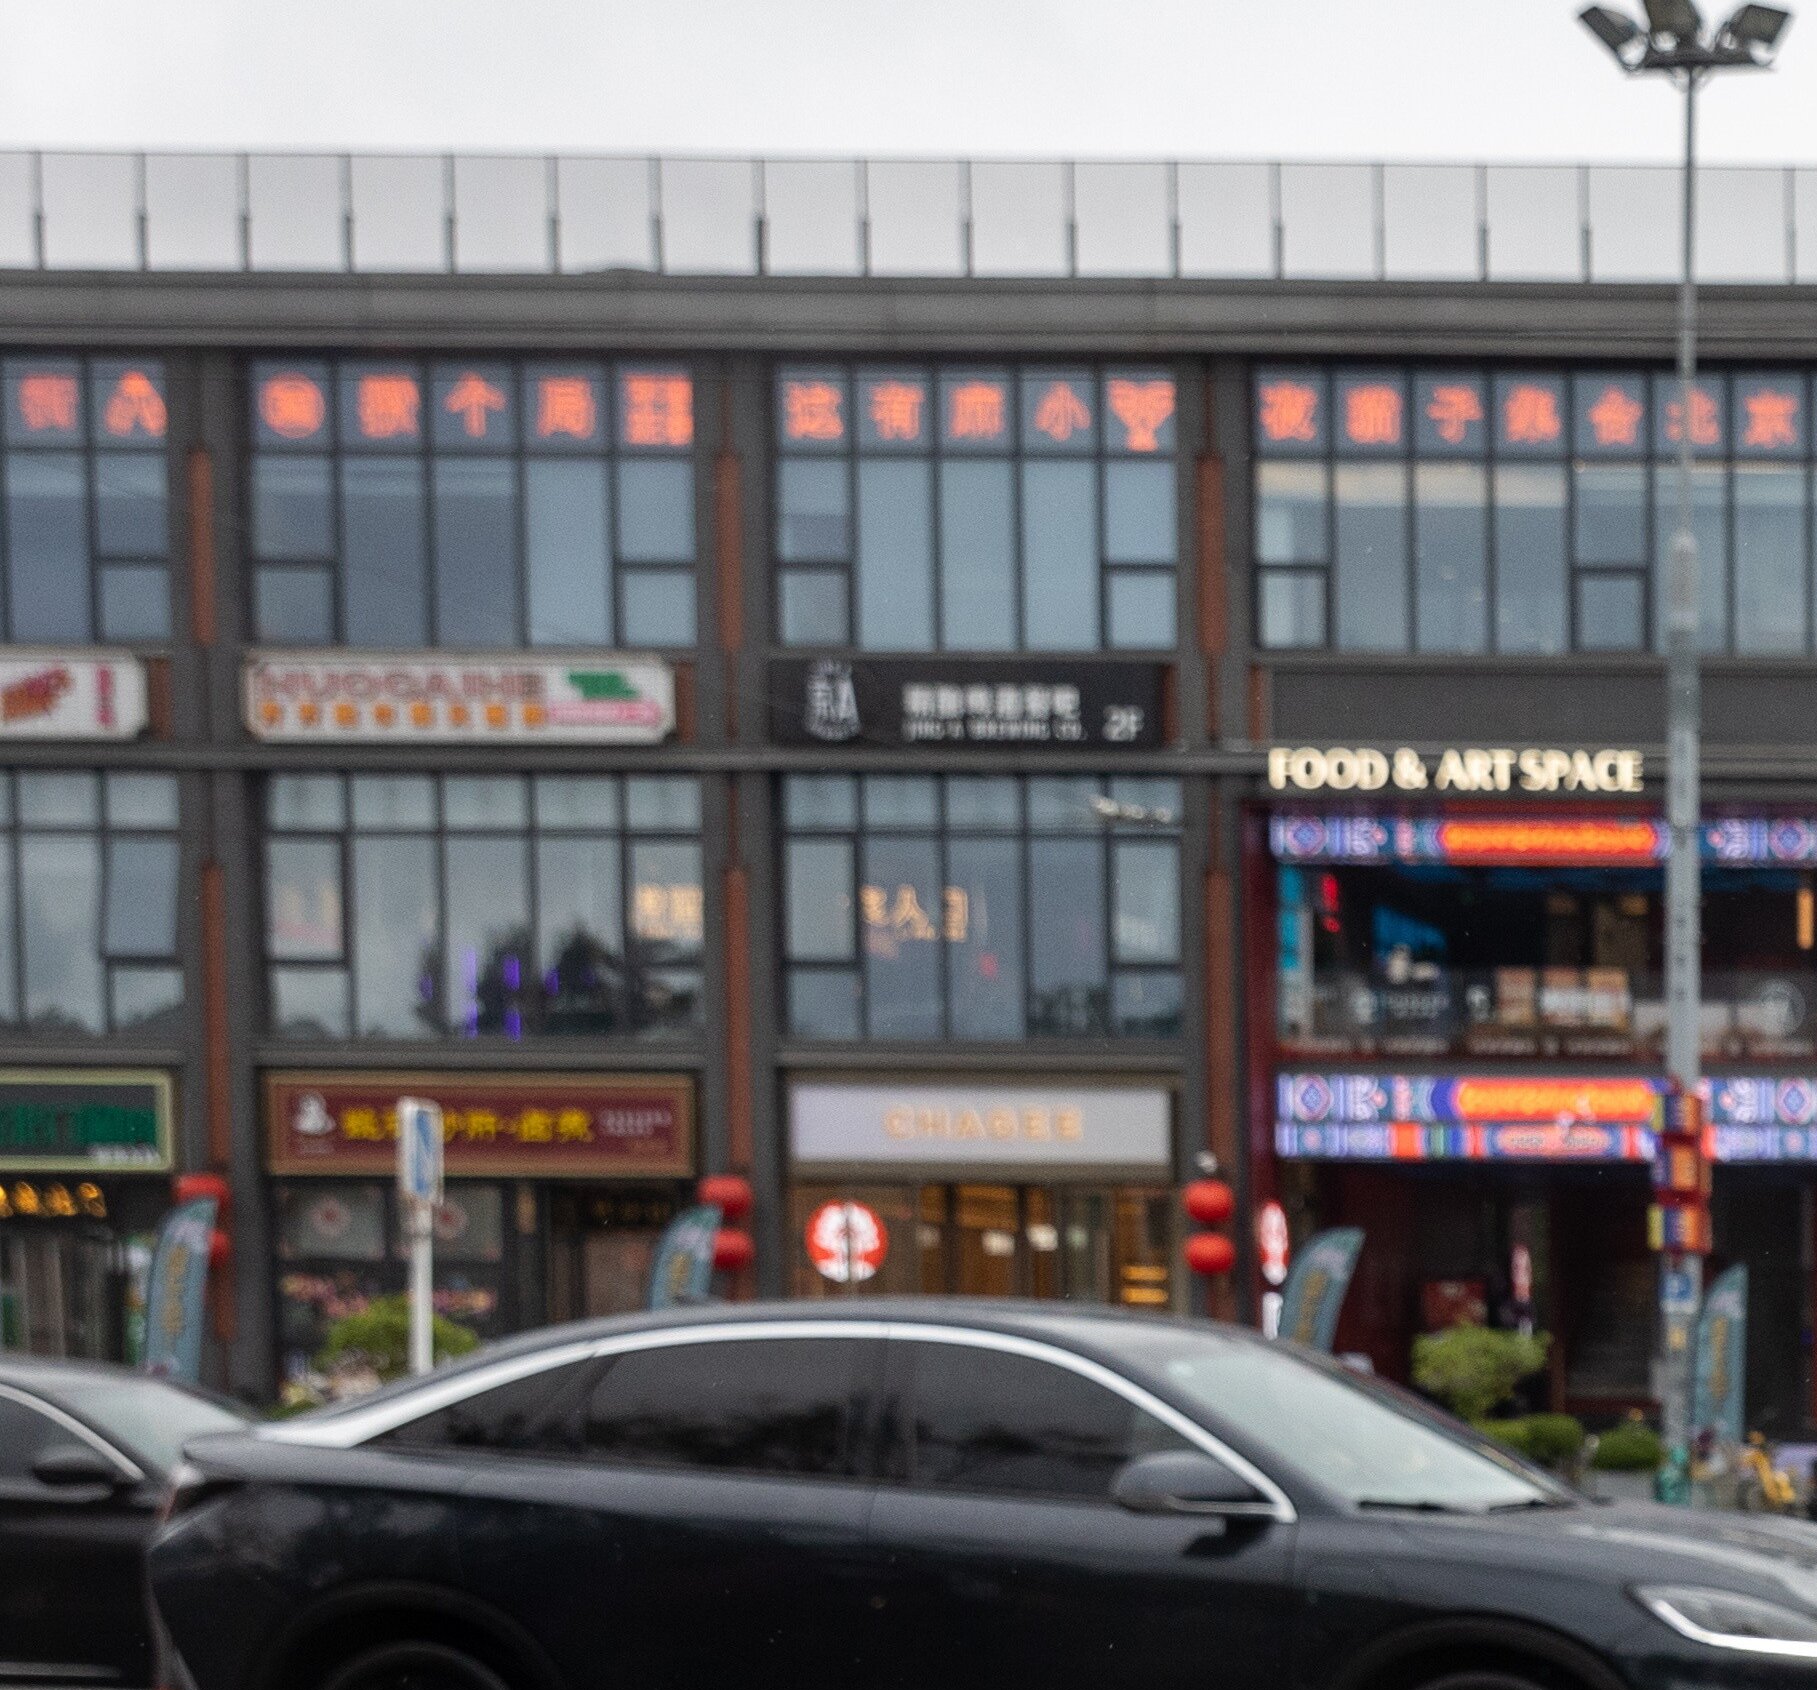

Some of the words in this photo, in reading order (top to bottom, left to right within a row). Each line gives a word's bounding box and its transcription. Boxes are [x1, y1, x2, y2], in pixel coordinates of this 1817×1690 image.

[1266, 746, 1390, 791] FOOD
[1391, 746, 1429, 791] &
[1434, 747, 1518, 793] ART
[1519, 748, 1645, 793] SPACE
